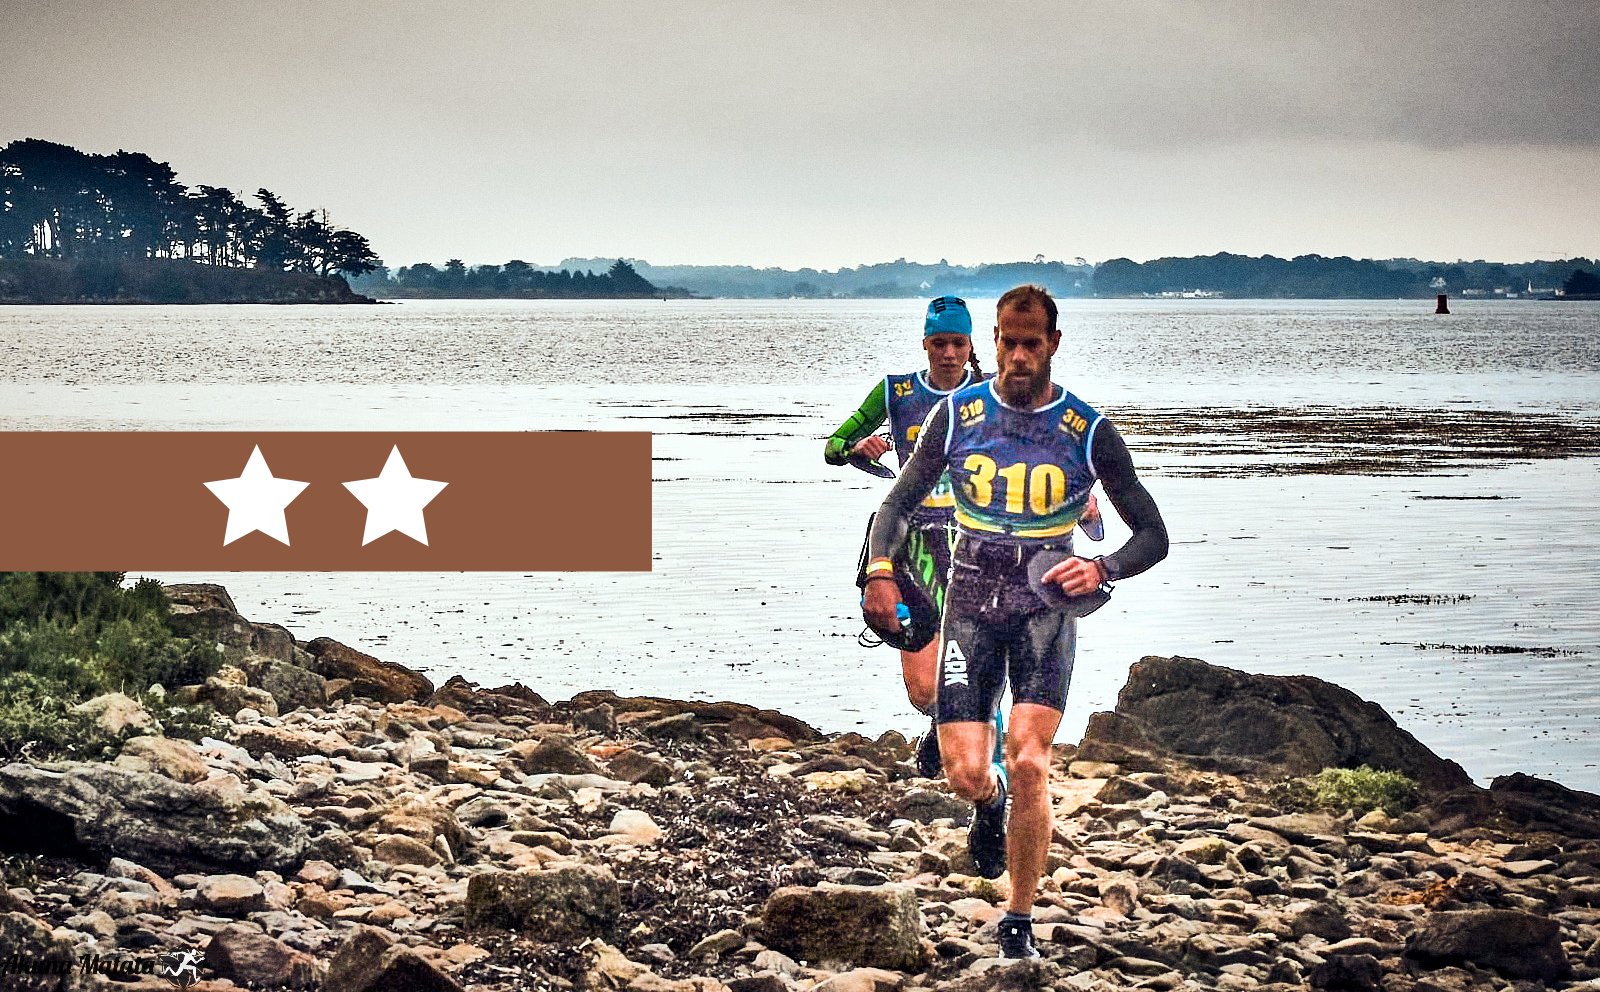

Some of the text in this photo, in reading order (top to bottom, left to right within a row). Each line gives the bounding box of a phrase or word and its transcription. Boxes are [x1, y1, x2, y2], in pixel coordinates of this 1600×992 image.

[960, 399, 984, 421] 310
[1063, 408, 1087, 432] 310
[961, 453, 1066, 515] 310
